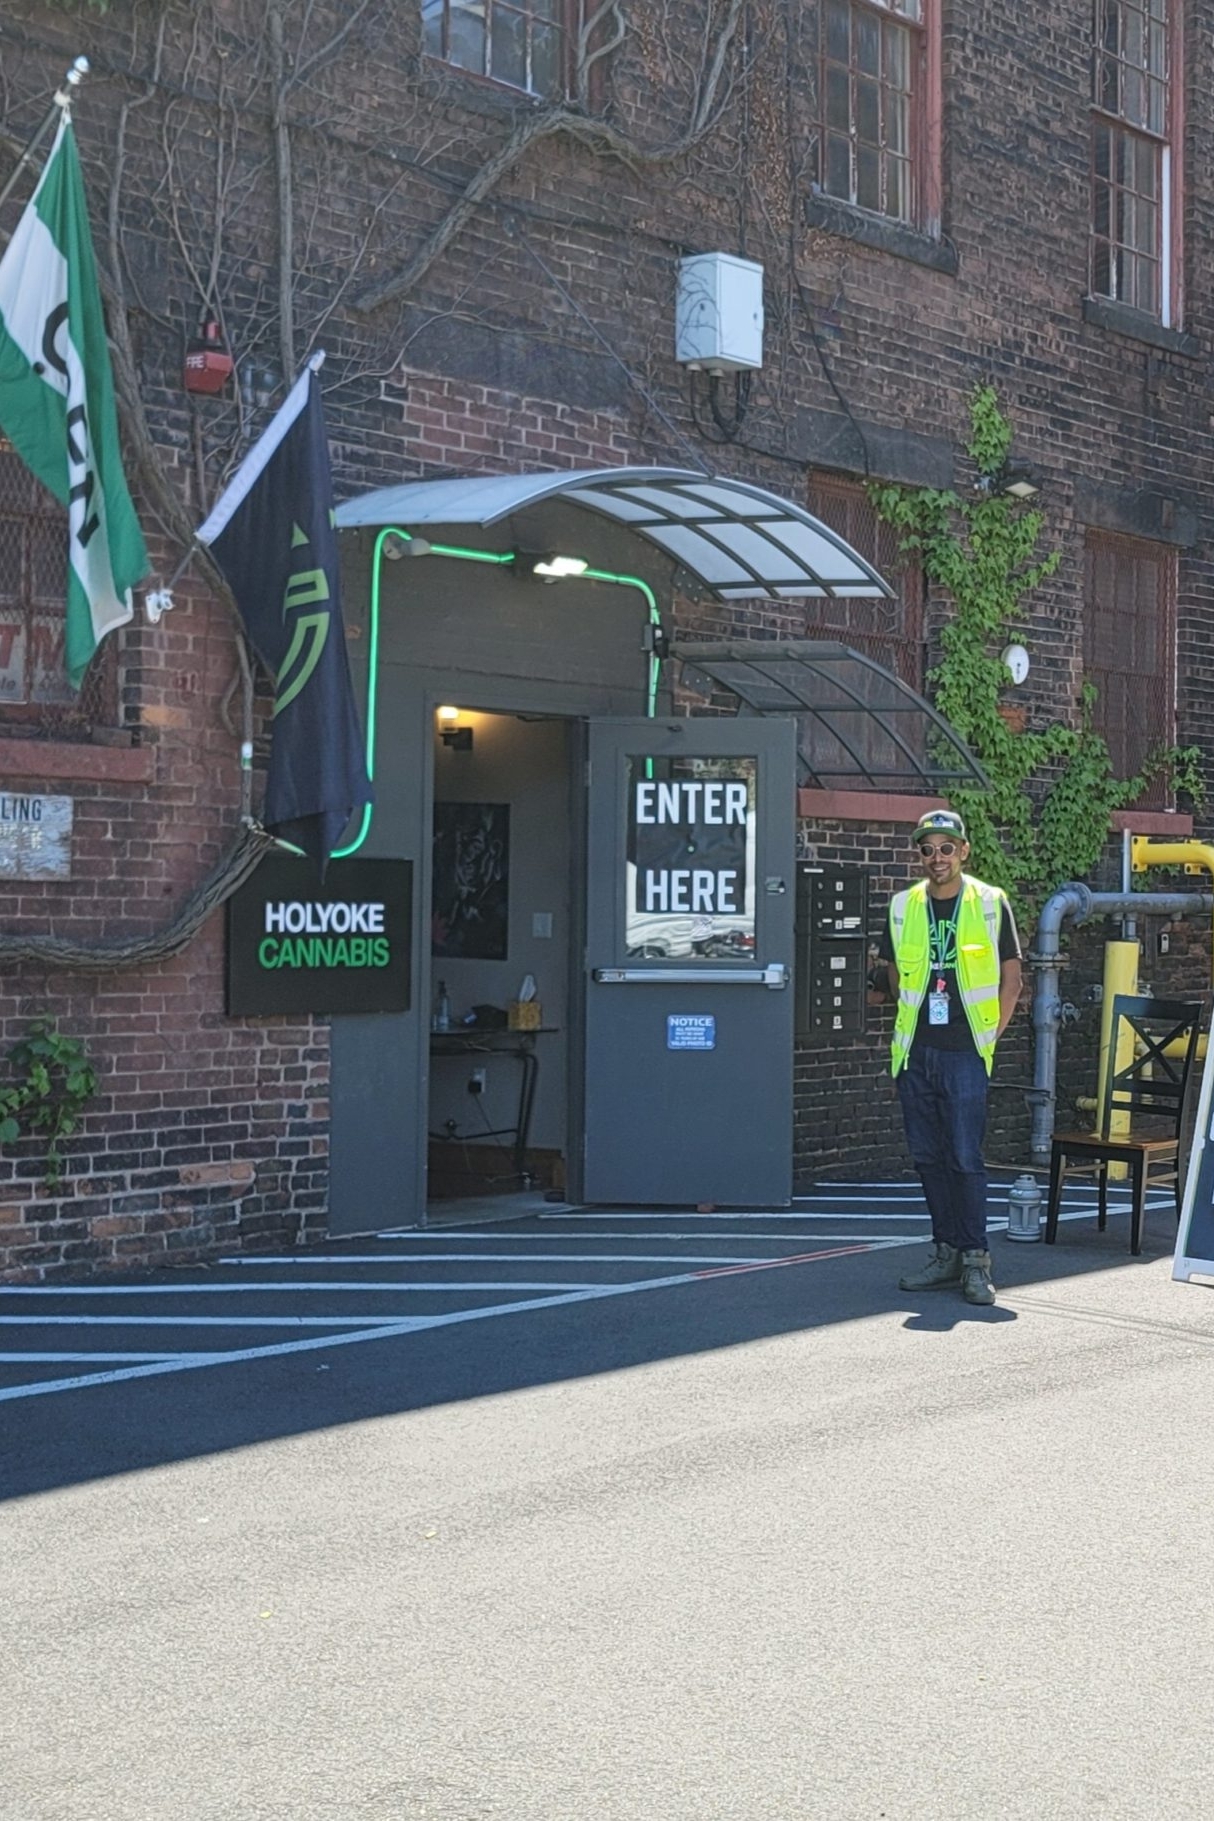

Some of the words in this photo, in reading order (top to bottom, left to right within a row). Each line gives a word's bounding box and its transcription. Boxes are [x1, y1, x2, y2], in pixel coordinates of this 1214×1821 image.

[186, 355, 204, 369] FIRE
[636, 782, 748, 825] ENTER
[646, 869, 737, 912] HERE
[265, 902, 385, 933] HOLYOKE
[258, 937, 390, 969] CANNABIS
[670, 1018, 713, 1027] NOTICE
